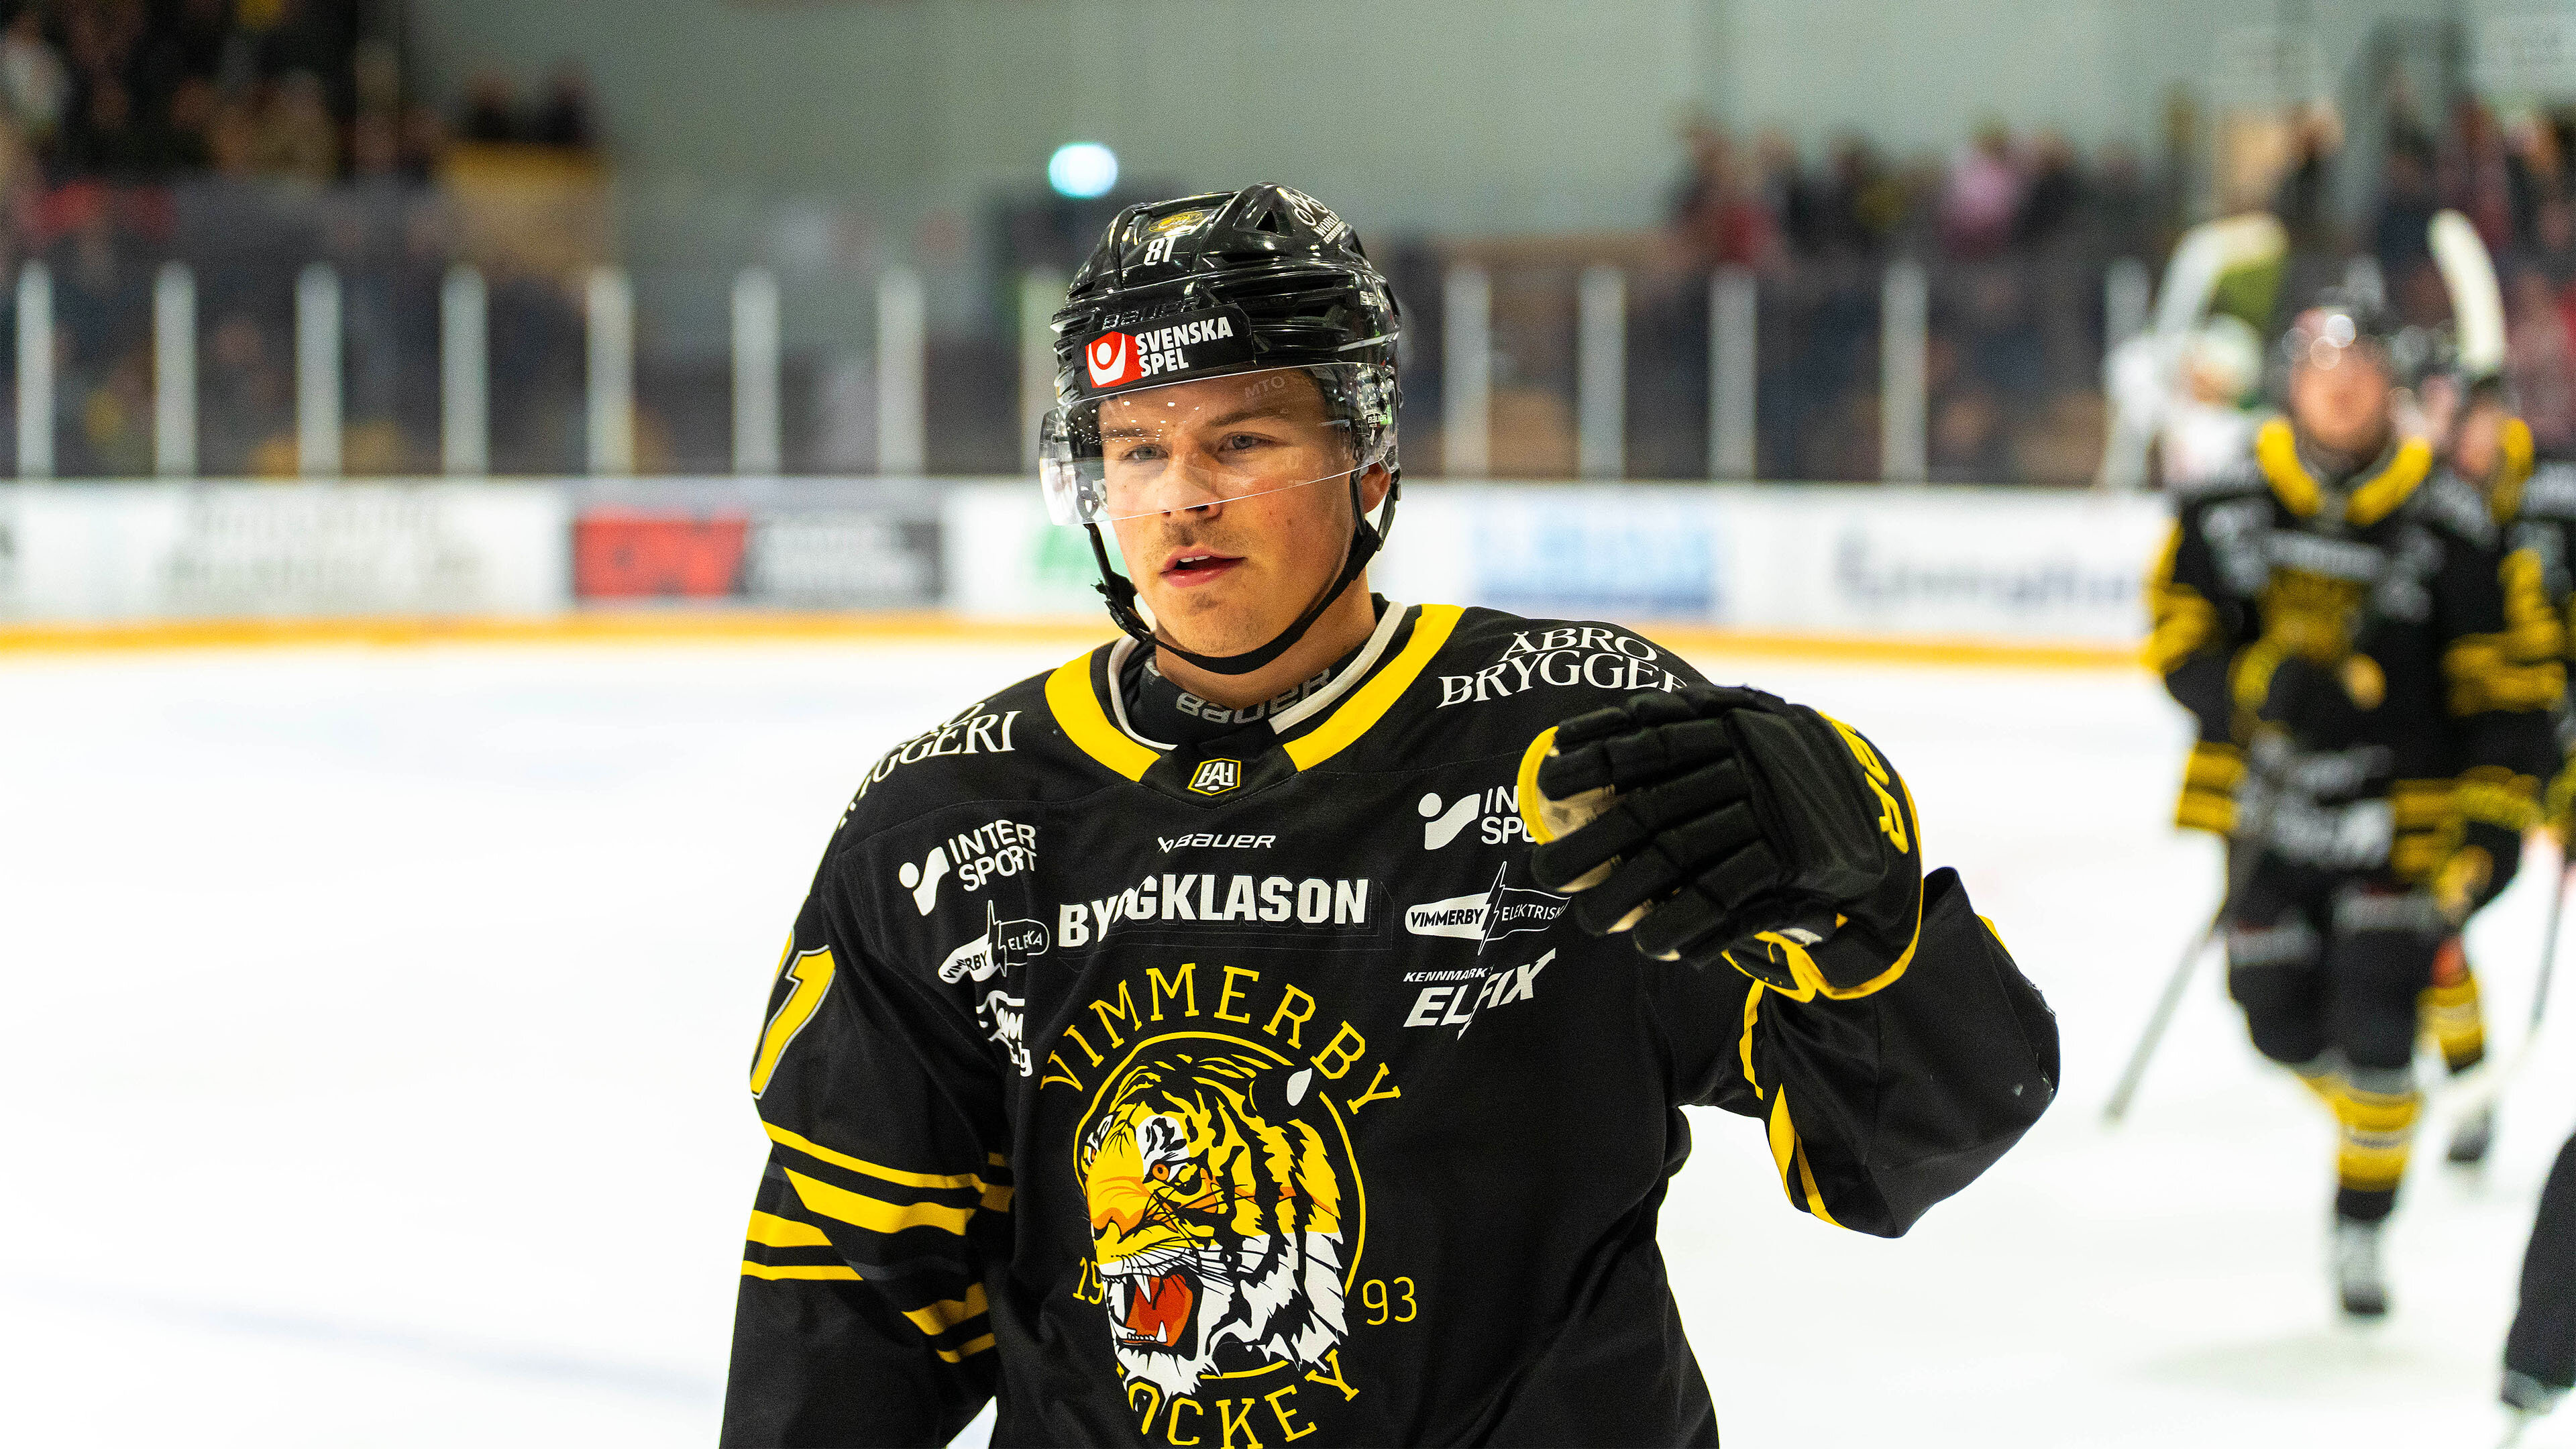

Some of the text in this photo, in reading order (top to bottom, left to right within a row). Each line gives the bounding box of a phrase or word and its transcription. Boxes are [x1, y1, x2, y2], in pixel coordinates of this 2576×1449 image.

[1135, 317, 1234, 356] SVENSKA
[1138, 348, 1189, 378] SPEL
[1497, 627, 1658, 663] ÅBRO
[1176, 667, 1330, 724] BAUER
[1436, 649, 1688, 709] BRYGGER
[948, 819, 1036, 864] INTER
[1173, 833, 1277, 849] BAUER
[959, 845, 1037, 892] SPORT
[1411, 908, 1484, 928] VIMMERBY
[1403, 964, 1495, 982] KENNMARK
[1403, 947, 1556, 1040] ELFIX
[1040, 962, 1401, 1116] VIMMERBY
[1073, 1256, 1104, 1305] 19
[1362, 1277, 1417, 1326] 93
[1116, 1348, 1360, 1449] OCKEY
